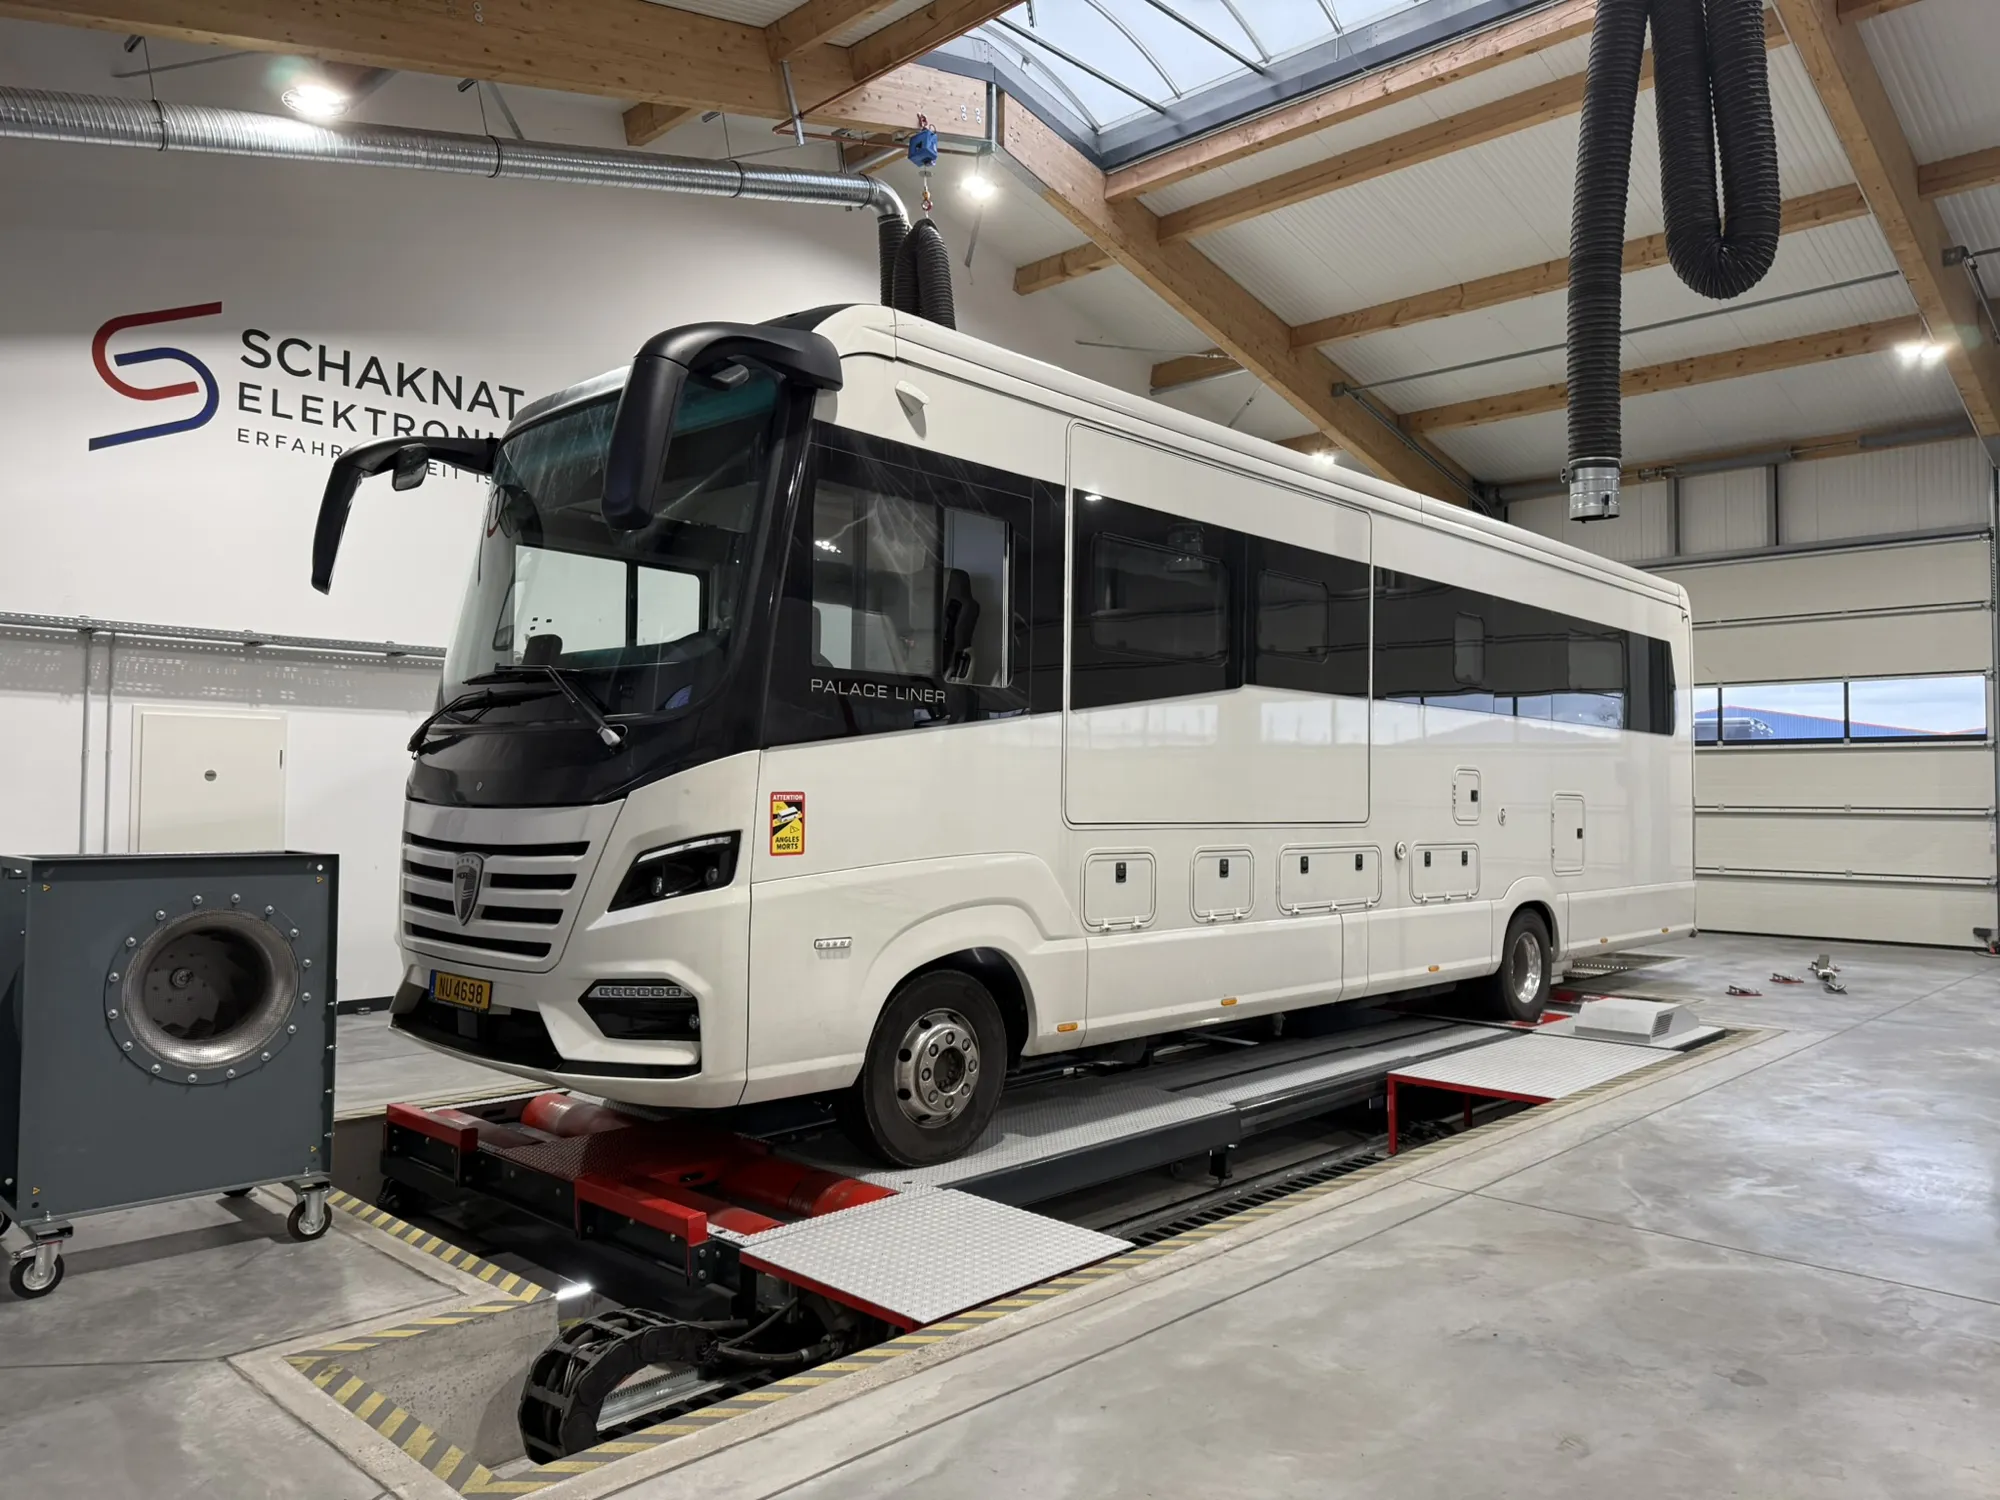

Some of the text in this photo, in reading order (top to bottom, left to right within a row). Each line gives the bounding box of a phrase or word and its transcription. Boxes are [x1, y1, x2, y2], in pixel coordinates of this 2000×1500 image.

[240, 328, 525, 421] SCHAKNAT
[238, 381, 495, 440] ELEKTRO
[810, 678, 946, 704] PALACE LINER
[454, 979, 483, 1005] 4698
